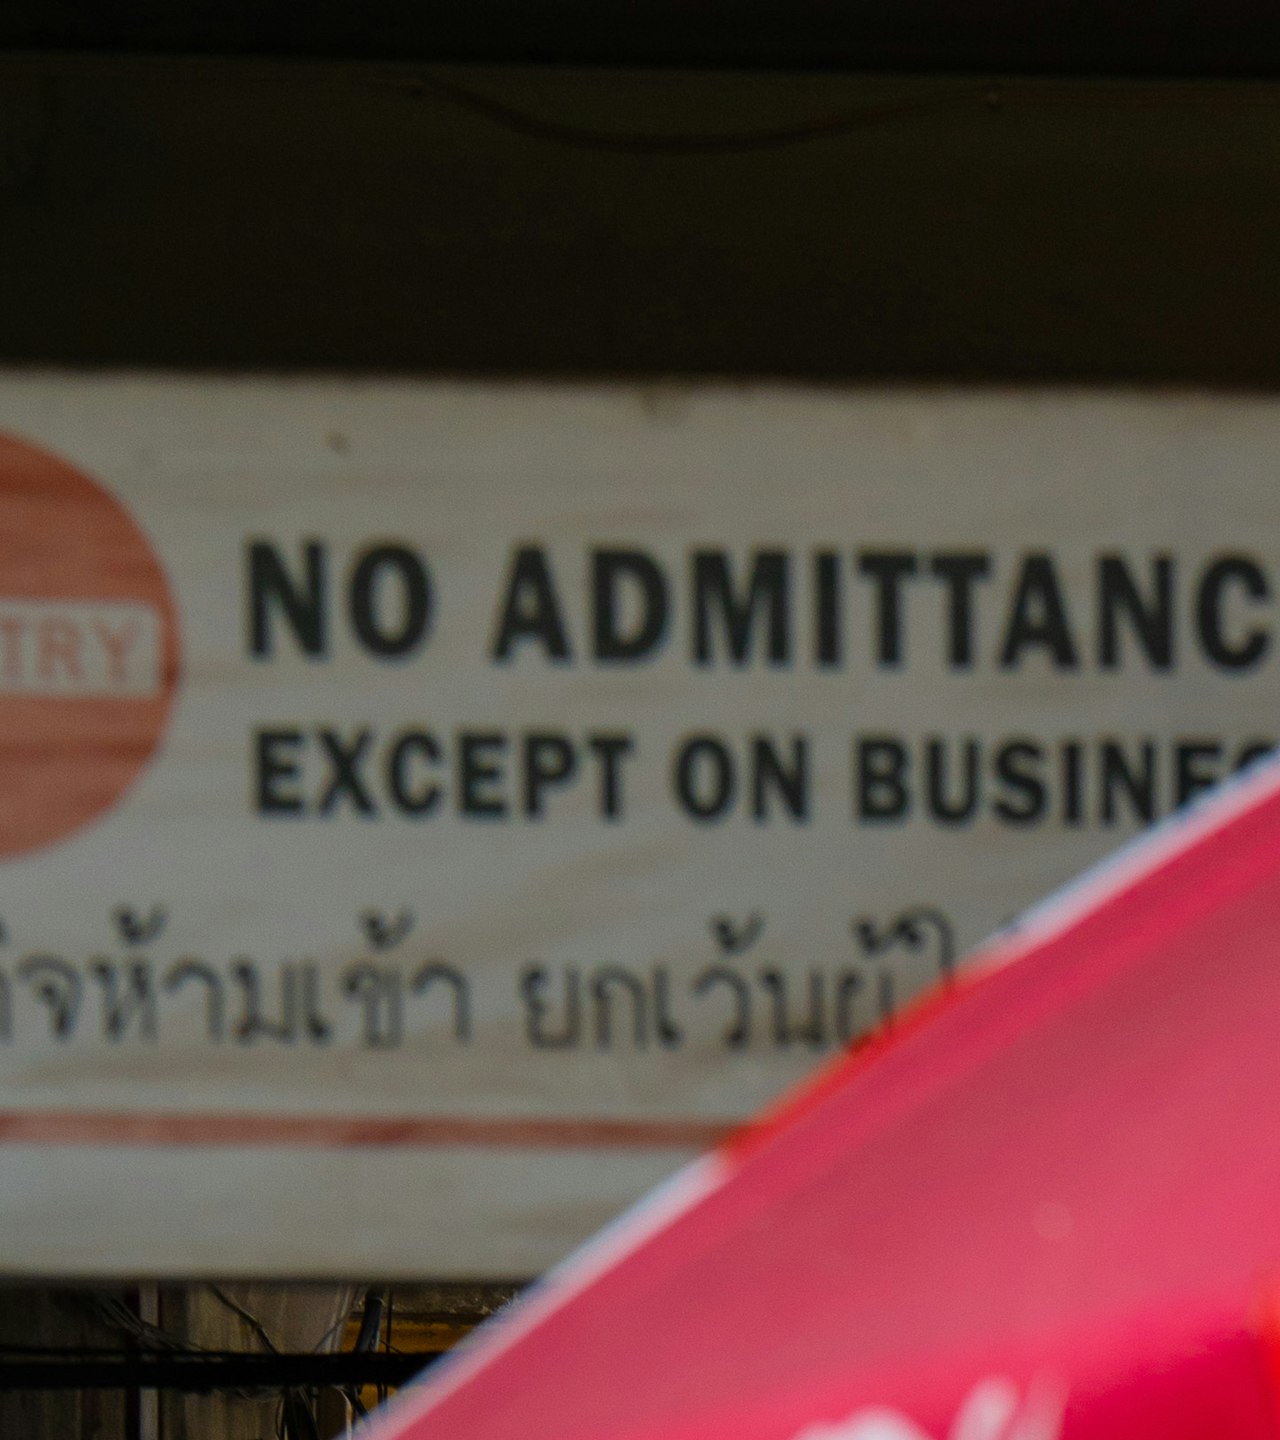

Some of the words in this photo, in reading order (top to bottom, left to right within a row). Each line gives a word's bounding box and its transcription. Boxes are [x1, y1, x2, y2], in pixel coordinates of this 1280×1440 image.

[243, 536, 435, 663] NO
[253, 726, 633, 821] EXCEPT
[675, 735, 811, 824] ON
